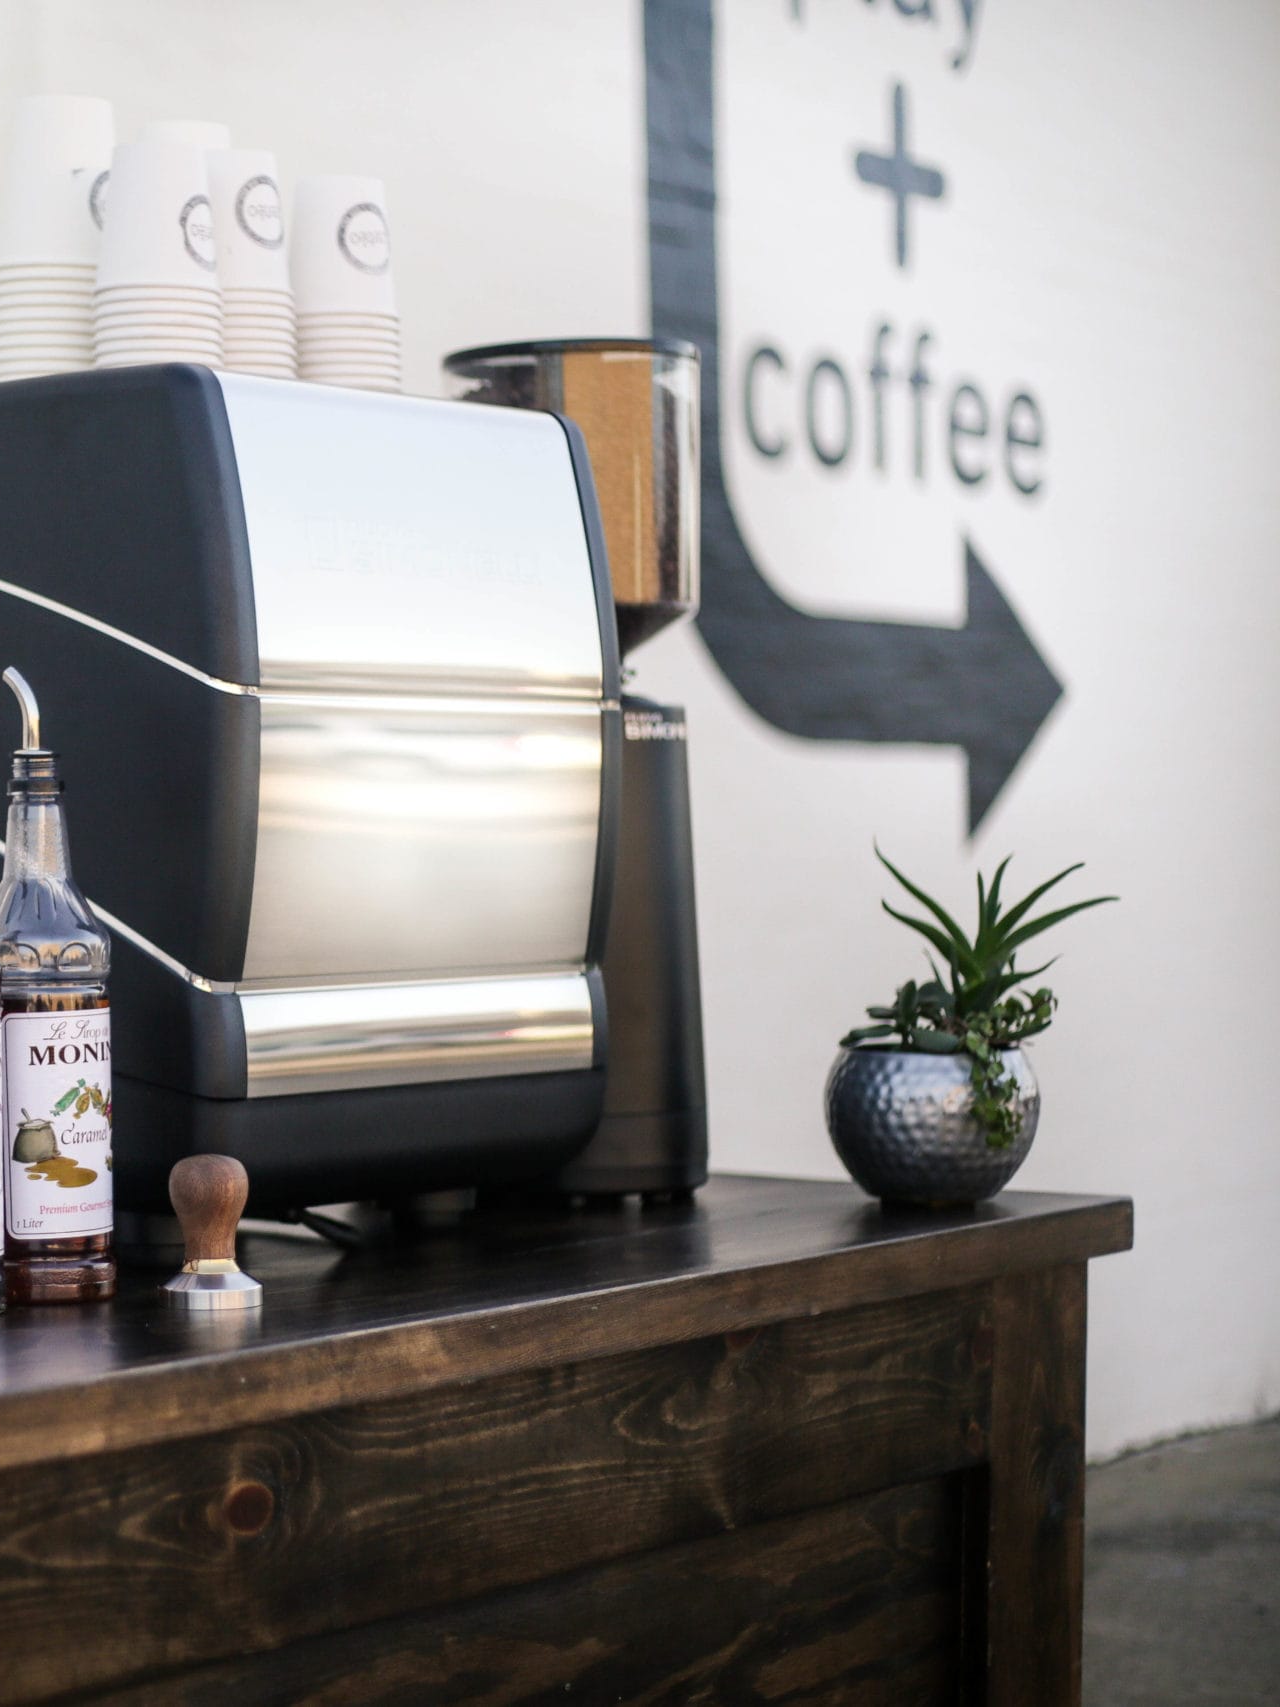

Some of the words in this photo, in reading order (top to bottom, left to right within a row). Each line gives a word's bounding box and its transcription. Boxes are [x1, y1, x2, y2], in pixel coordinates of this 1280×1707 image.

[743, 322, 1044, 496] coffee
[42, 1020, 67, 1041] Le
[39, 1203, 79, 1216] Premium
[23, 1218, 44, 1229] Liter
